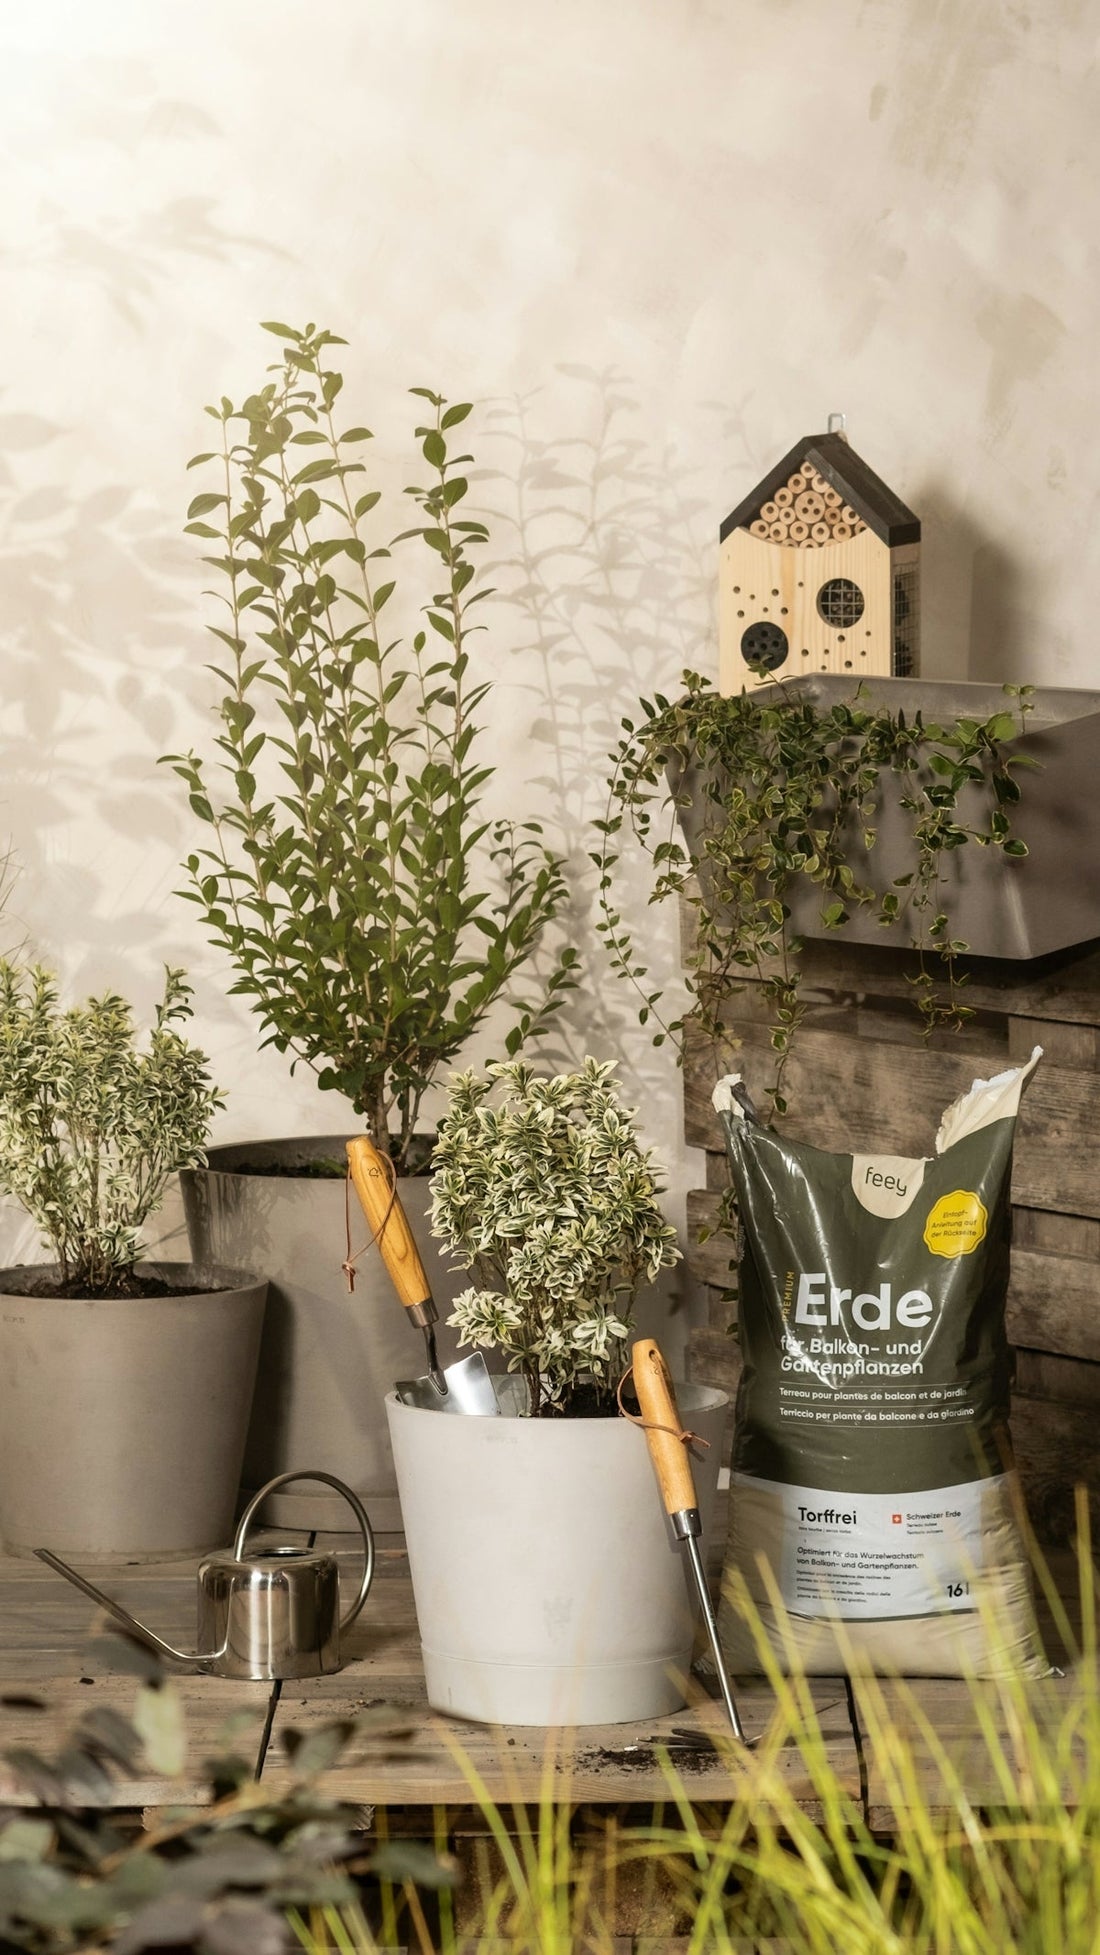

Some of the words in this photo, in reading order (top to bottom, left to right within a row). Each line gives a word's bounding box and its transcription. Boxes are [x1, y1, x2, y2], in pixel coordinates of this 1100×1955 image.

[865, 1166, 907, 1197] feey
[781, 1271, 795, 1322] PREMIUM
[795, 1273, 933, 1330] Erde
[810, 1338, 880, 1355] Balkon-
[886, 1339, 922, 1354] und
[780, 1355, 924, 1378] Gartenpflanzen
[779, 1387, 810, 1398] Terreau
[812, 1391, 832, 1400] pour
[834, 1391, 868, 1401] plantes
[870, 1392, 882, 1400] de
[884, 1392, 916, 1400] balcon
[918, 1391, 928, 1399] et
[929, 1390, 942, 1399] de
[943, 1387, 967, 1399] jardin
[779, 1407, 814, 1419] Terriccio
[815, 1412, 830, 1420] per
[832, 1411, 862, 1421] plante
[864, 1412, 877, 1421] da
[879, 1411, 916, 1421] balcone
[918, 1412, 926, 1420] e
[926, 1410, 939, 1419] da
[940, 1407, 974, 1420] giardino
[798, 1507, 857, 1525] Torffrei
[906, 1512, 943, 1520] Schweizer
[945, 1510, 962, 1518] Erde
[797, 1546, 831, 1557] Optimiert
[844, 1551, 859, 1559] das
[860, 1552, 924, 1560] Wurzelwachstum
[811, 1559, 840, 1567] Balkon-
[947, 1583, 963, 1598] 16
